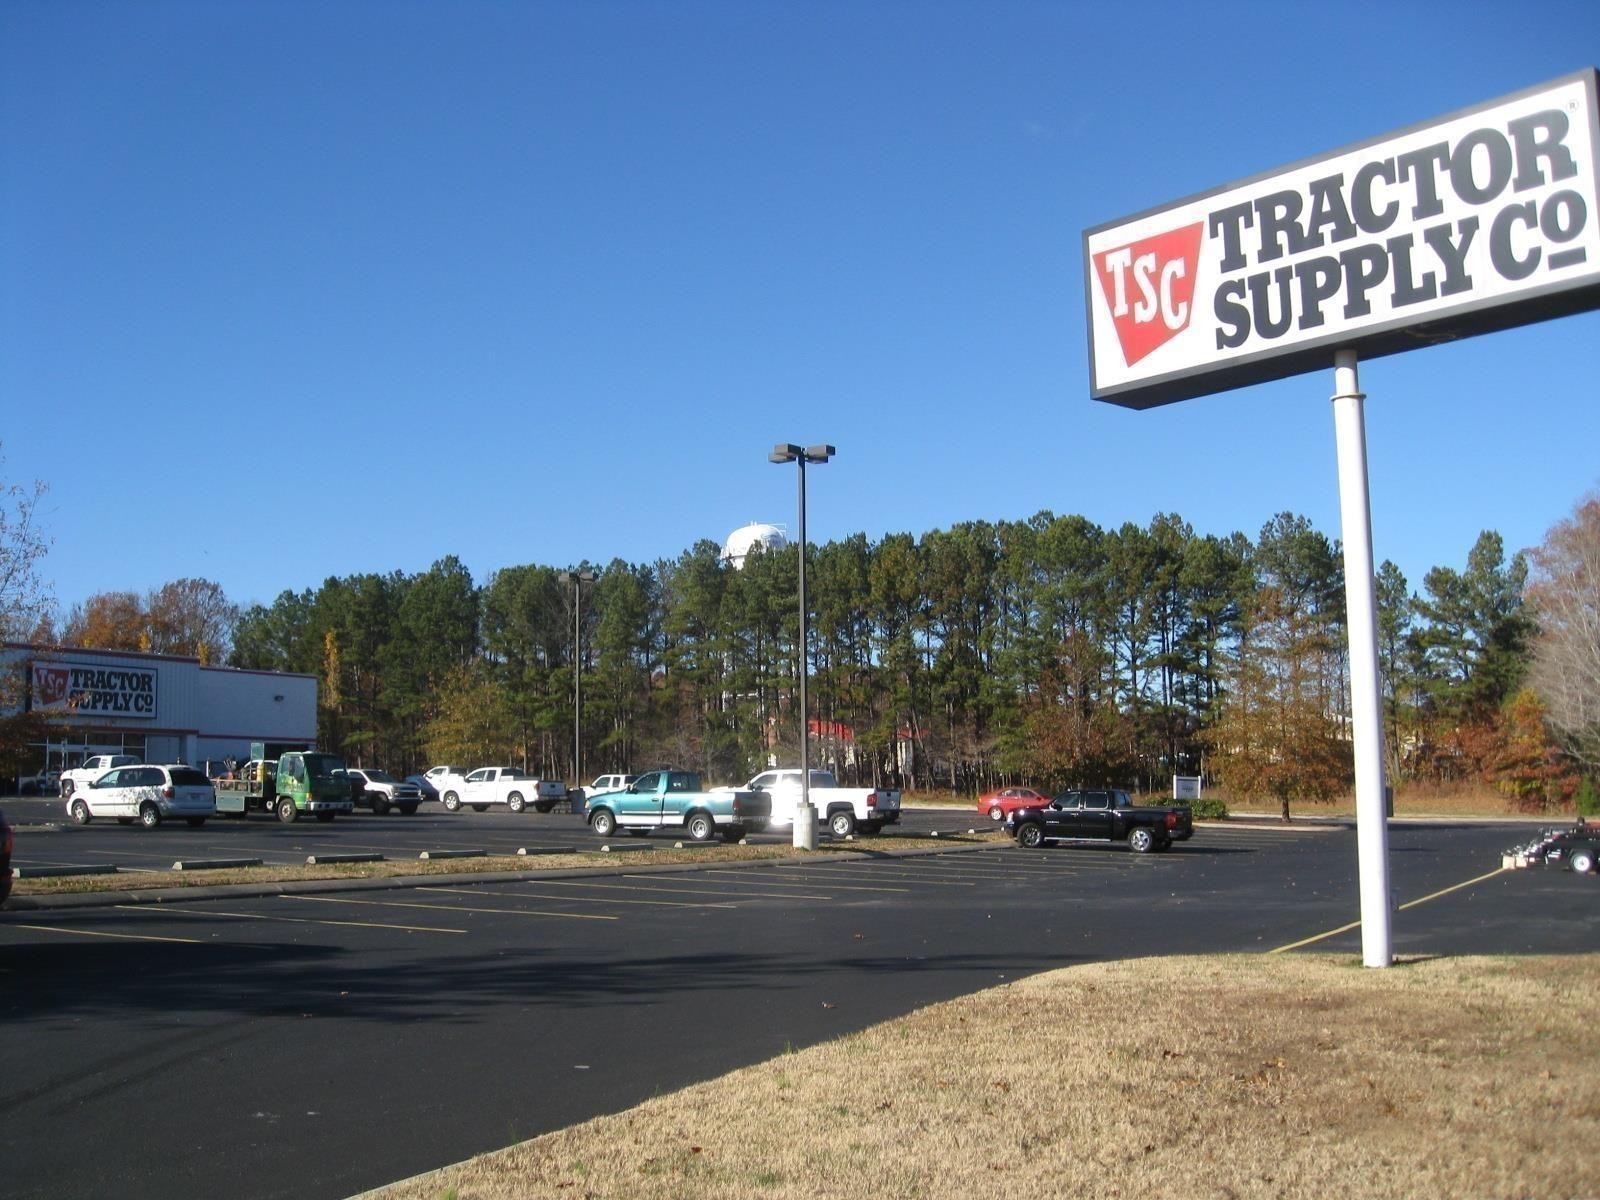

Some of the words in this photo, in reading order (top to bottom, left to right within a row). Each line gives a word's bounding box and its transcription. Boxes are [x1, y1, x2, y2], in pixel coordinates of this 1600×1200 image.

[1208, 108, 1578, 274] TRACTOR
[1105, 247, 1189, 331] TSC
[1213, 214, 1480, 351] SUPPLY
[38, 669, 64, 698] TSC
[70, 668, 153, 692] TRACTOR
